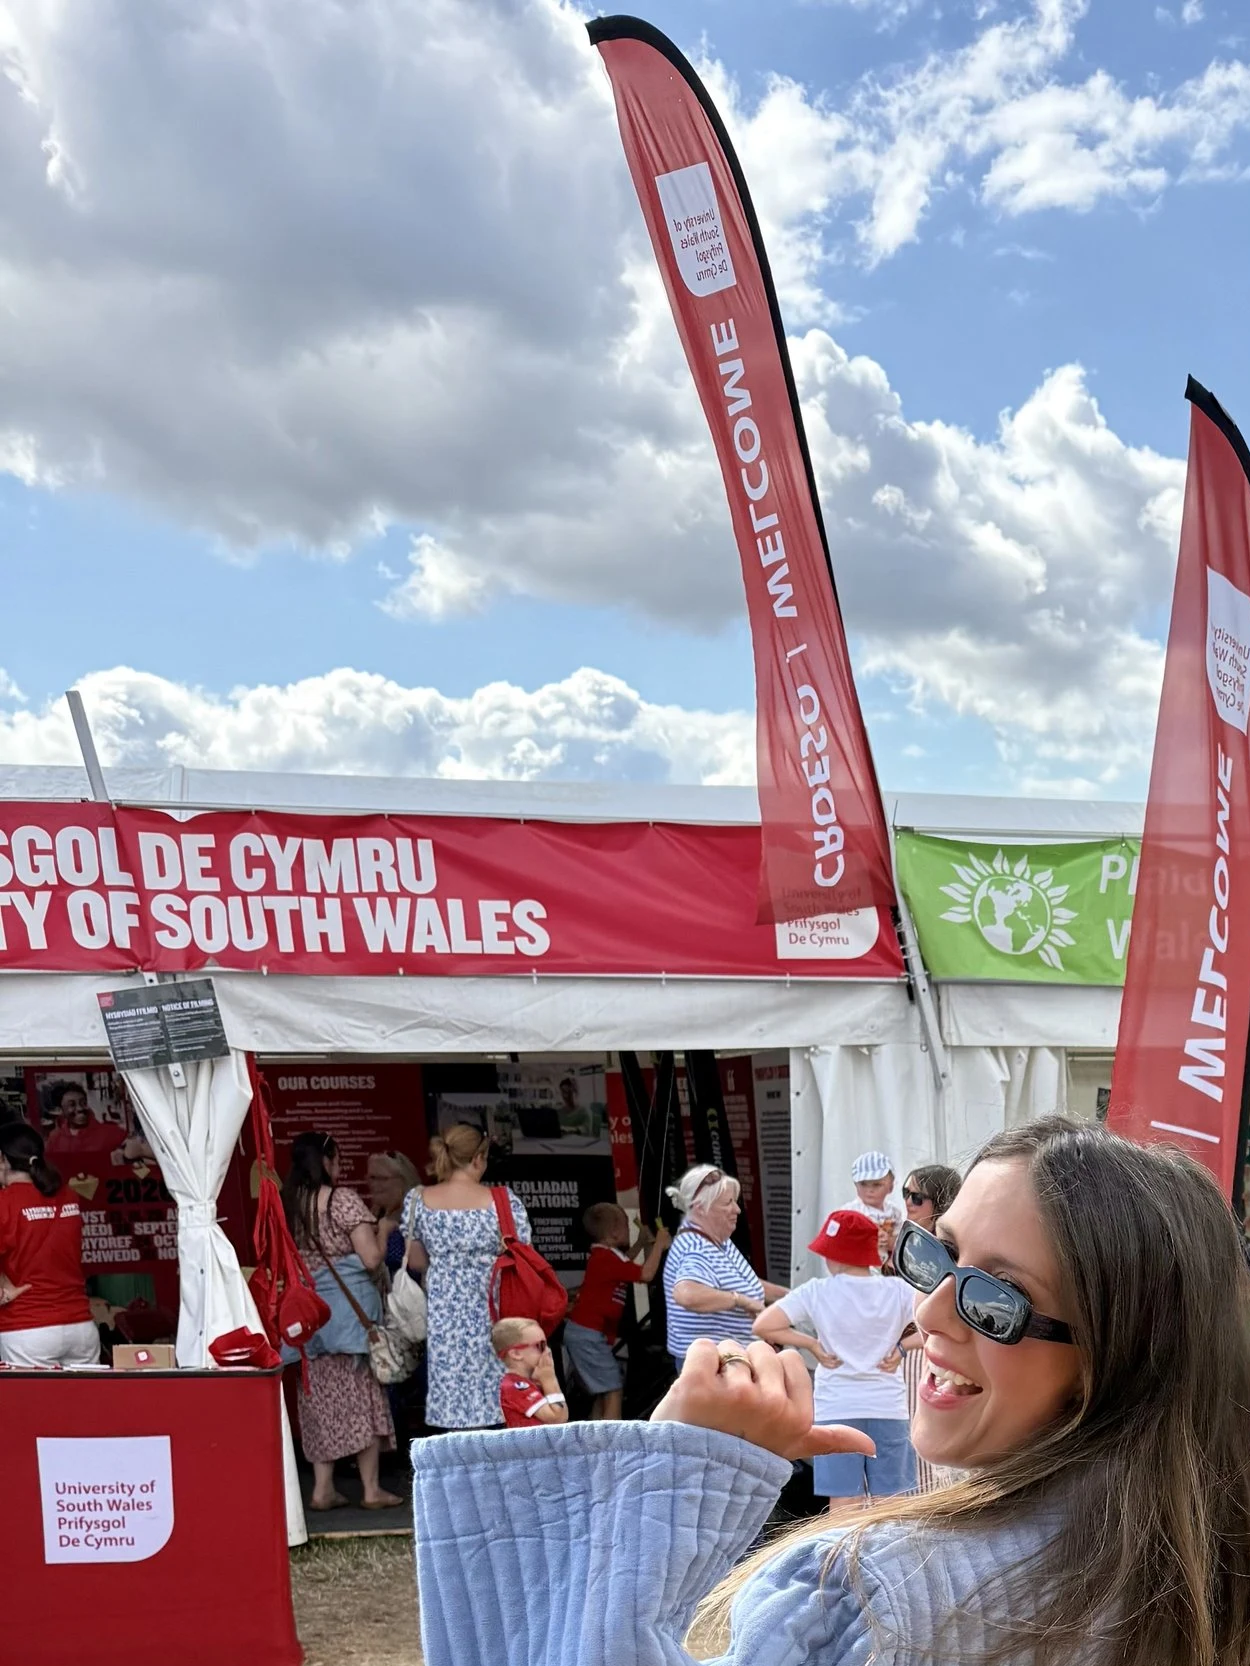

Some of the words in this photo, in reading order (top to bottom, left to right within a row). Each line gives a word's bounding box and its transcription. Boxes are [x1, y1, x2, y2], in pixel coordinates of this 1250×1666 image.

[138, 832, 222, 892] DE
[229, 832, 438, 895] CYMRU
[66, 889, 141, 949] OF
[150, 893, 347, 953] SOUTH
[352, 897, 551, 957] WALES
[788, 932, 806, 945] De
[809, 932, 850, 948] Cymru
[277, 1076, 309, 1091] OUR
[310, 1075, 376, 1090] COURSES
[55, 1482, 136, 1498] University
[139, 1480, 156, 1494] of
[56, 1499, 103, 1513] South
[106, 1498, 153, 1512] Wales
[57, 1516, 126, 1533] Prifysgol
[58, 1534, 81, 1548] De
[84, 1533, 136, 1550] Cymru
